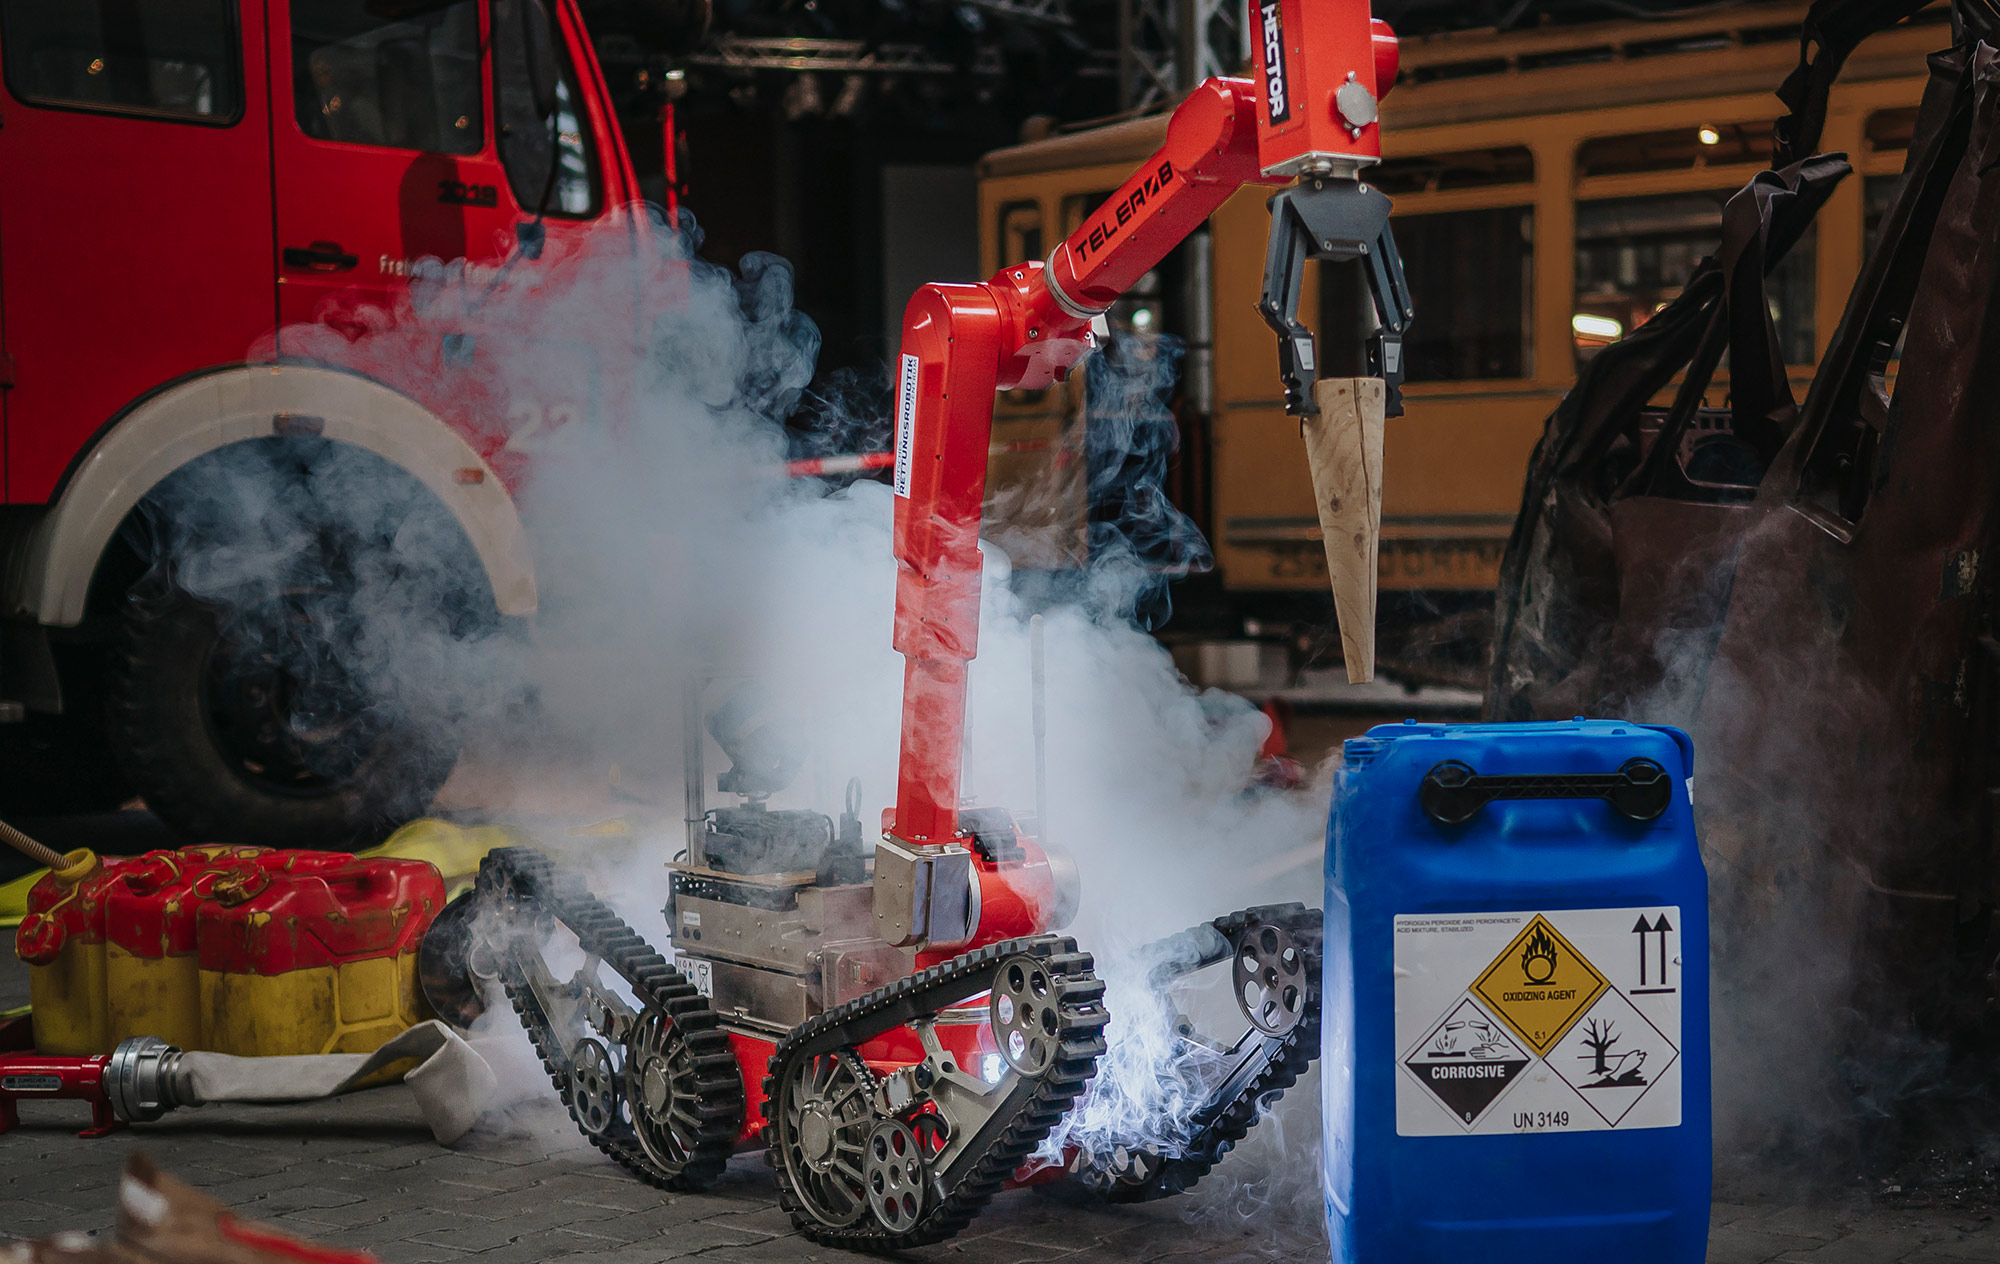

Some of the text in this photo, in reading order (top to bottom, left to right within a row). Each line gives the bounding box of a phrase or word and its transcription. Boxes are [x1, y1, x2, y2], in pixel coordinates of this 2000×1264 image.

[1261, 3, 1285, 118] HECTOR
[900, 358, 912, 494] RETTUNGSROBOTIK
[1502, 989, 1576, 1002] OXIDIZING AGENT
[1534, 1031, 1546, 1040] 5.1
[1431, 1065, 1506, 1079] CORROSIVE
[1465, 1112, 1472, 1121] 8
[1513, 1111, 1569, 1128] UN 3149
